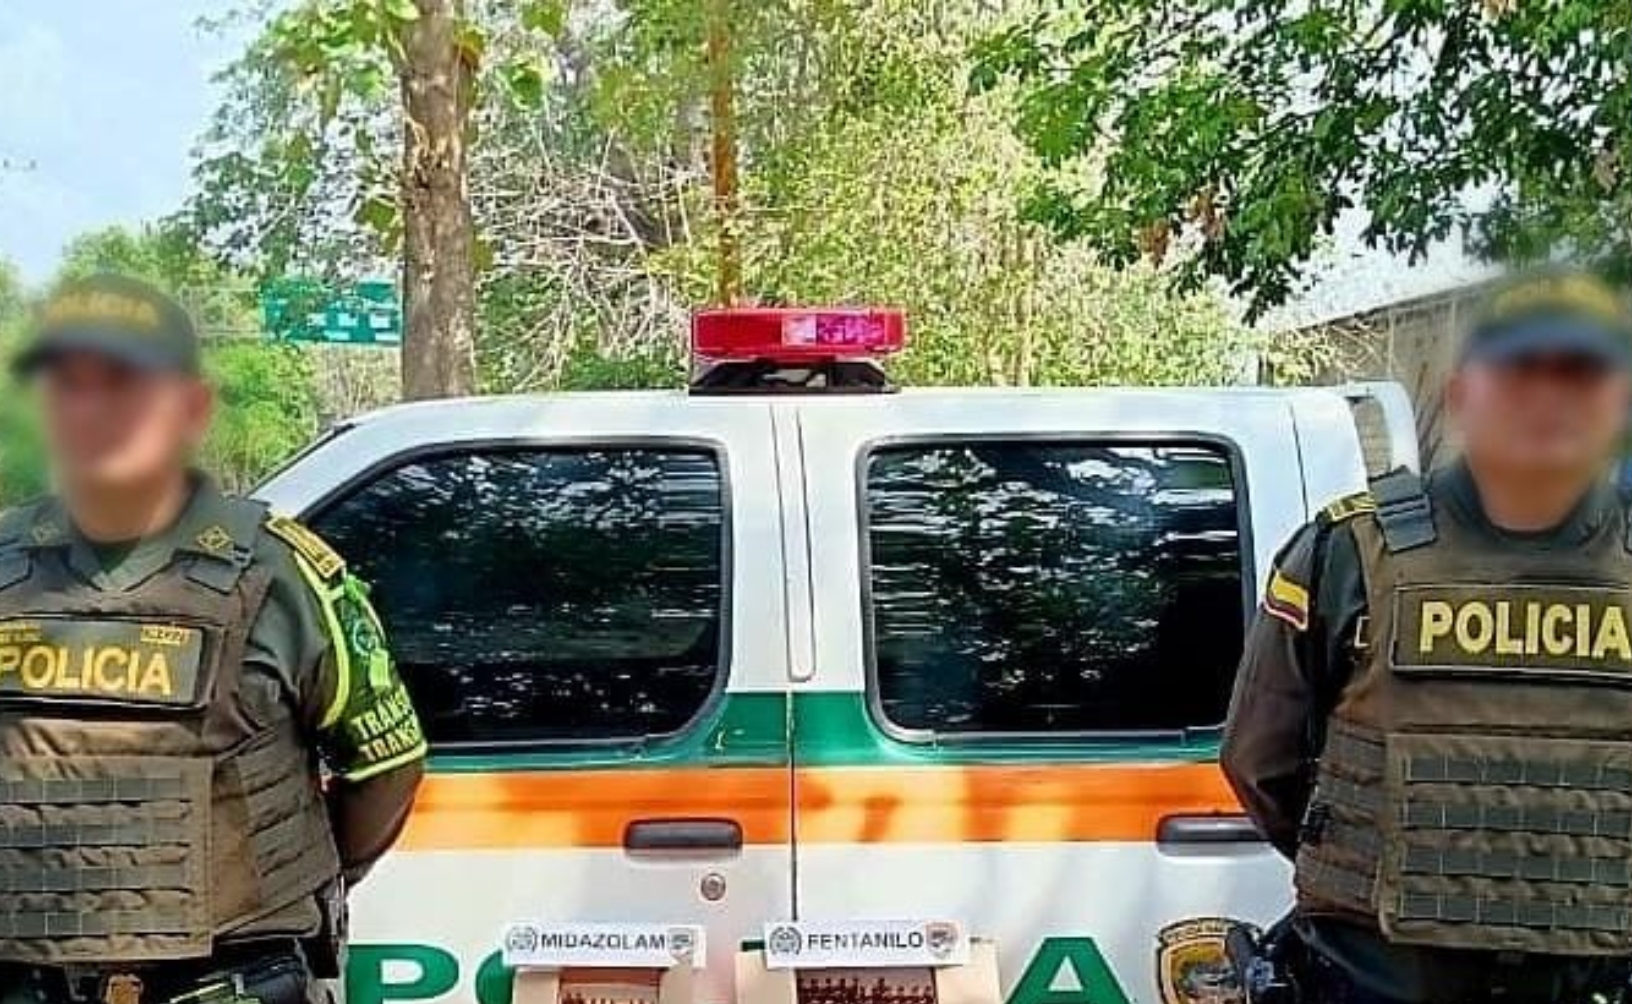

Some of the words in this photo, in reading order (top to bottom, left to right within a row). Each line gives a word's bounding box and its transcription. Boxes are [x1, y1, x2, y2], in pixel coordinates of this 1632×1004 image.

[1419, 601, 1632, 660] POLICIA
[0, 645, 172, 696] POLICIA
[540, 932, 666, 950] MIDAZOLAM
[806, 931, 923, 949] FENTANILO
